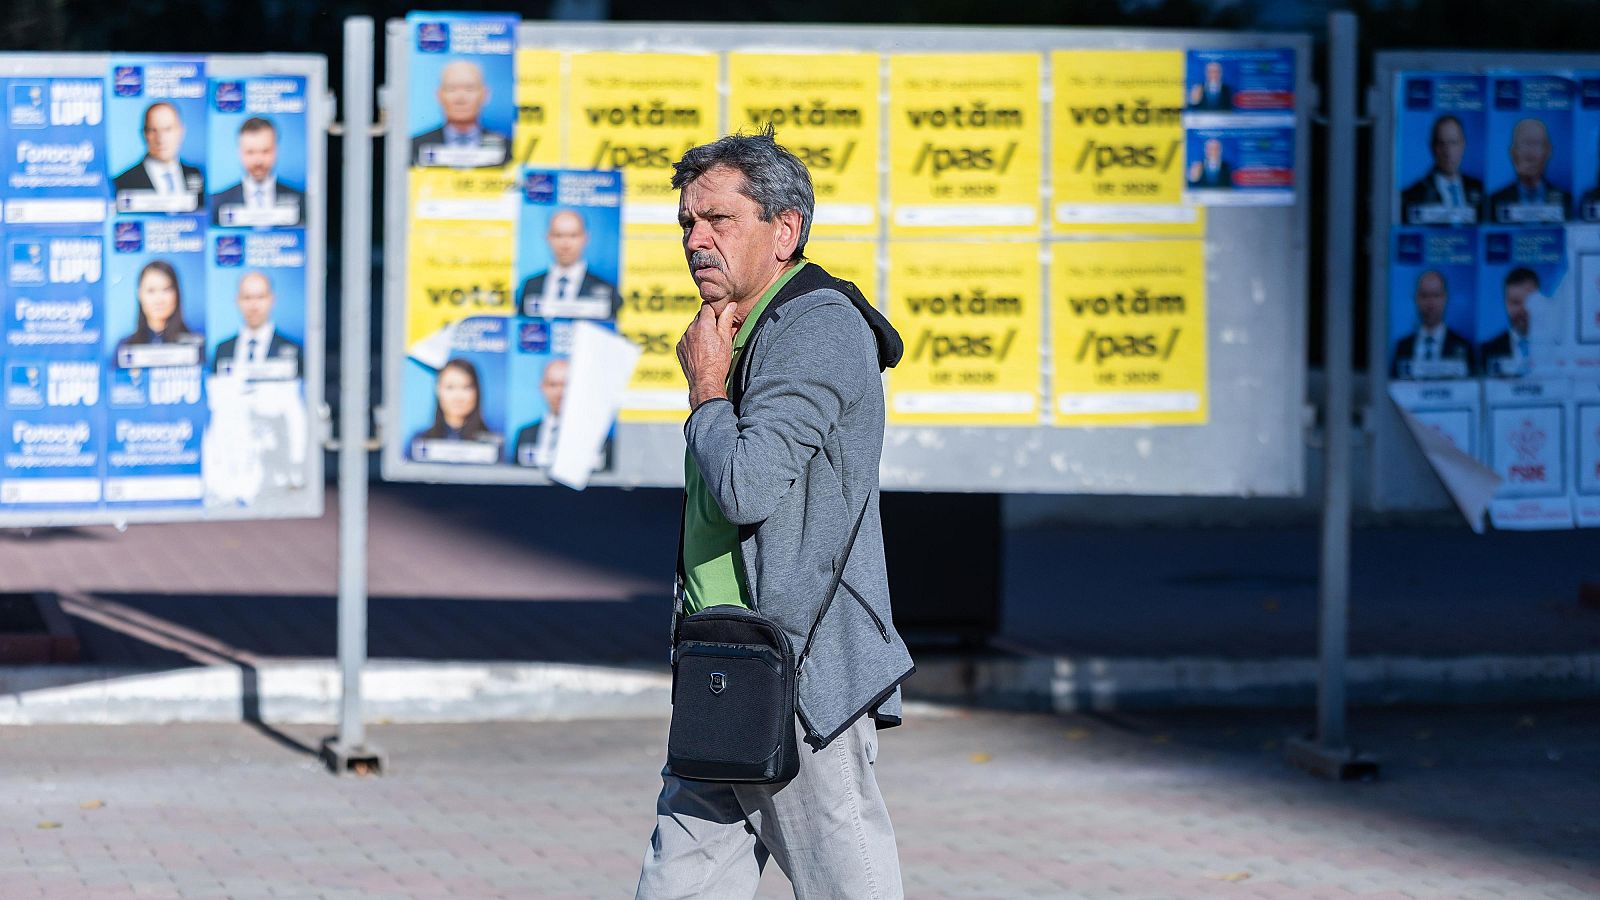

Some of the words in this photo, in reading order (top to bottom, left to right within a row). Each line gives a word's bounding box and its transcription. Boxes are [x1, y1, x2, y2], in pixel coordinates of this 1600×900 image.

[587, 102, 699, 126] votăm
[747, 100, 862, 127] votăm
[907, 100, 1023, 127] votăm
[1071, 99, 1185, 126] votăm
[594, 138, 697, 169] /pas
[912, 142, 1017, 176] /pas/
[1075, 140, 1181, 174] /pas/
[427, 282, 511, 306] votă
[907, 289, 1022, 316] votăm
[1070, 289, 1186, 316] votăm
[912, 329, 1017, 363] /pas/
[1076, 328, 1181, 363] /pas/
